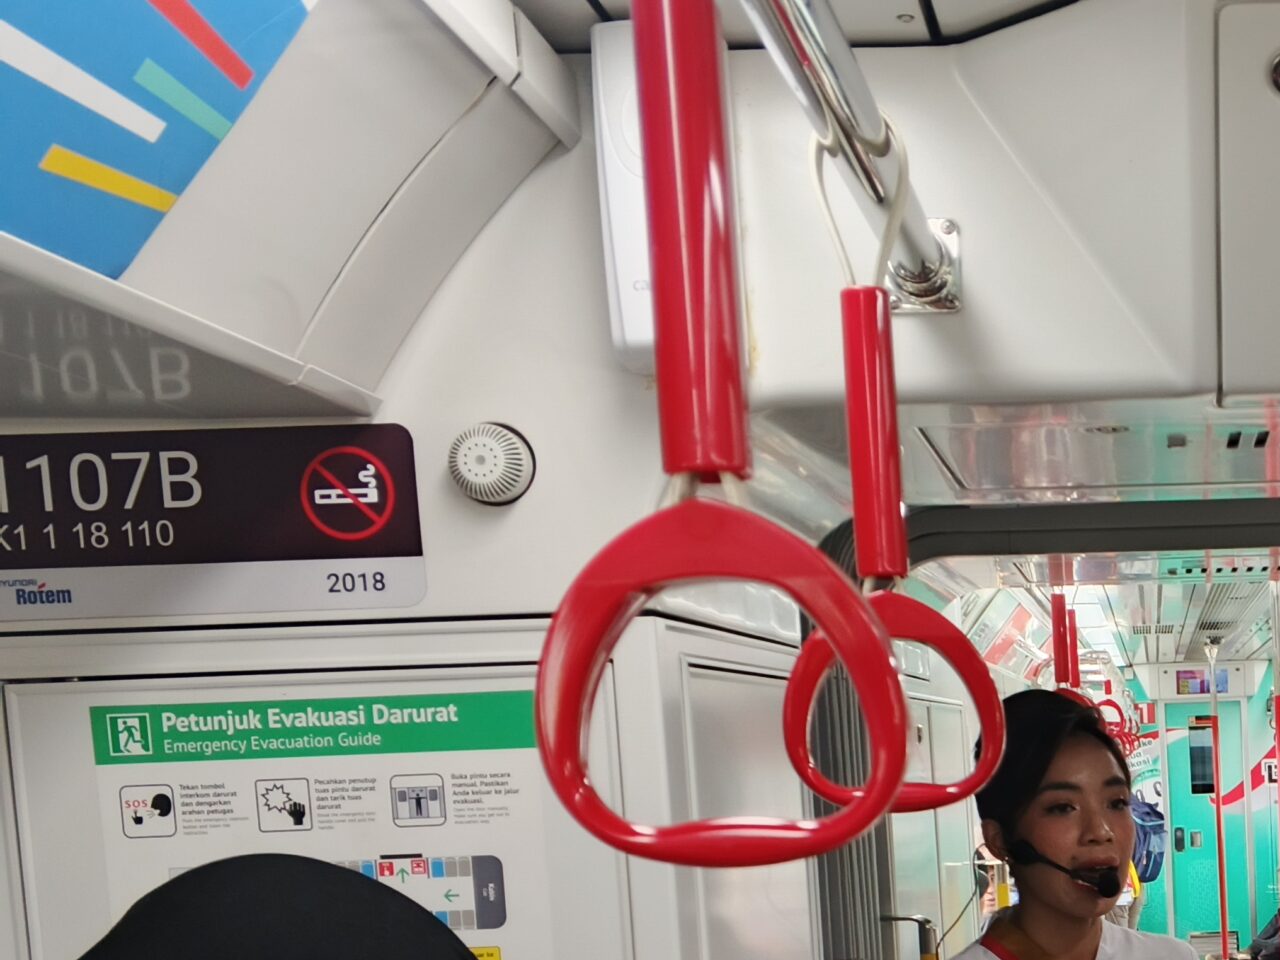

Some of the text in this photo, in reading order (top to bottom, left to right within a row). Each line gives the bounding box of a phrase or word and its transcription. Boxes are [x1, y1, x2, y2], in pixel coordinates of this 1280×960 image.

[0, 450, 202, 514] 1107B
[42, 523, 56, 550] 1
[72, 521, 109, 549] 18
[121, 519, 174, 547] 110
[0, 579, 38, 588] YUNDAI
[326, 571, 386, 593] 2018
[15, 583, 73, 605] Rotem
[161, 703, 459, 735] Petunjuk Evakuasi Darurat
[163, 731, 382, 756] Emergency Evacuation Guide
[124, 799, 149, 809] SOS
[195, 800, 232, 808] dengarkan
[206, 808, 235, 816] petugas
